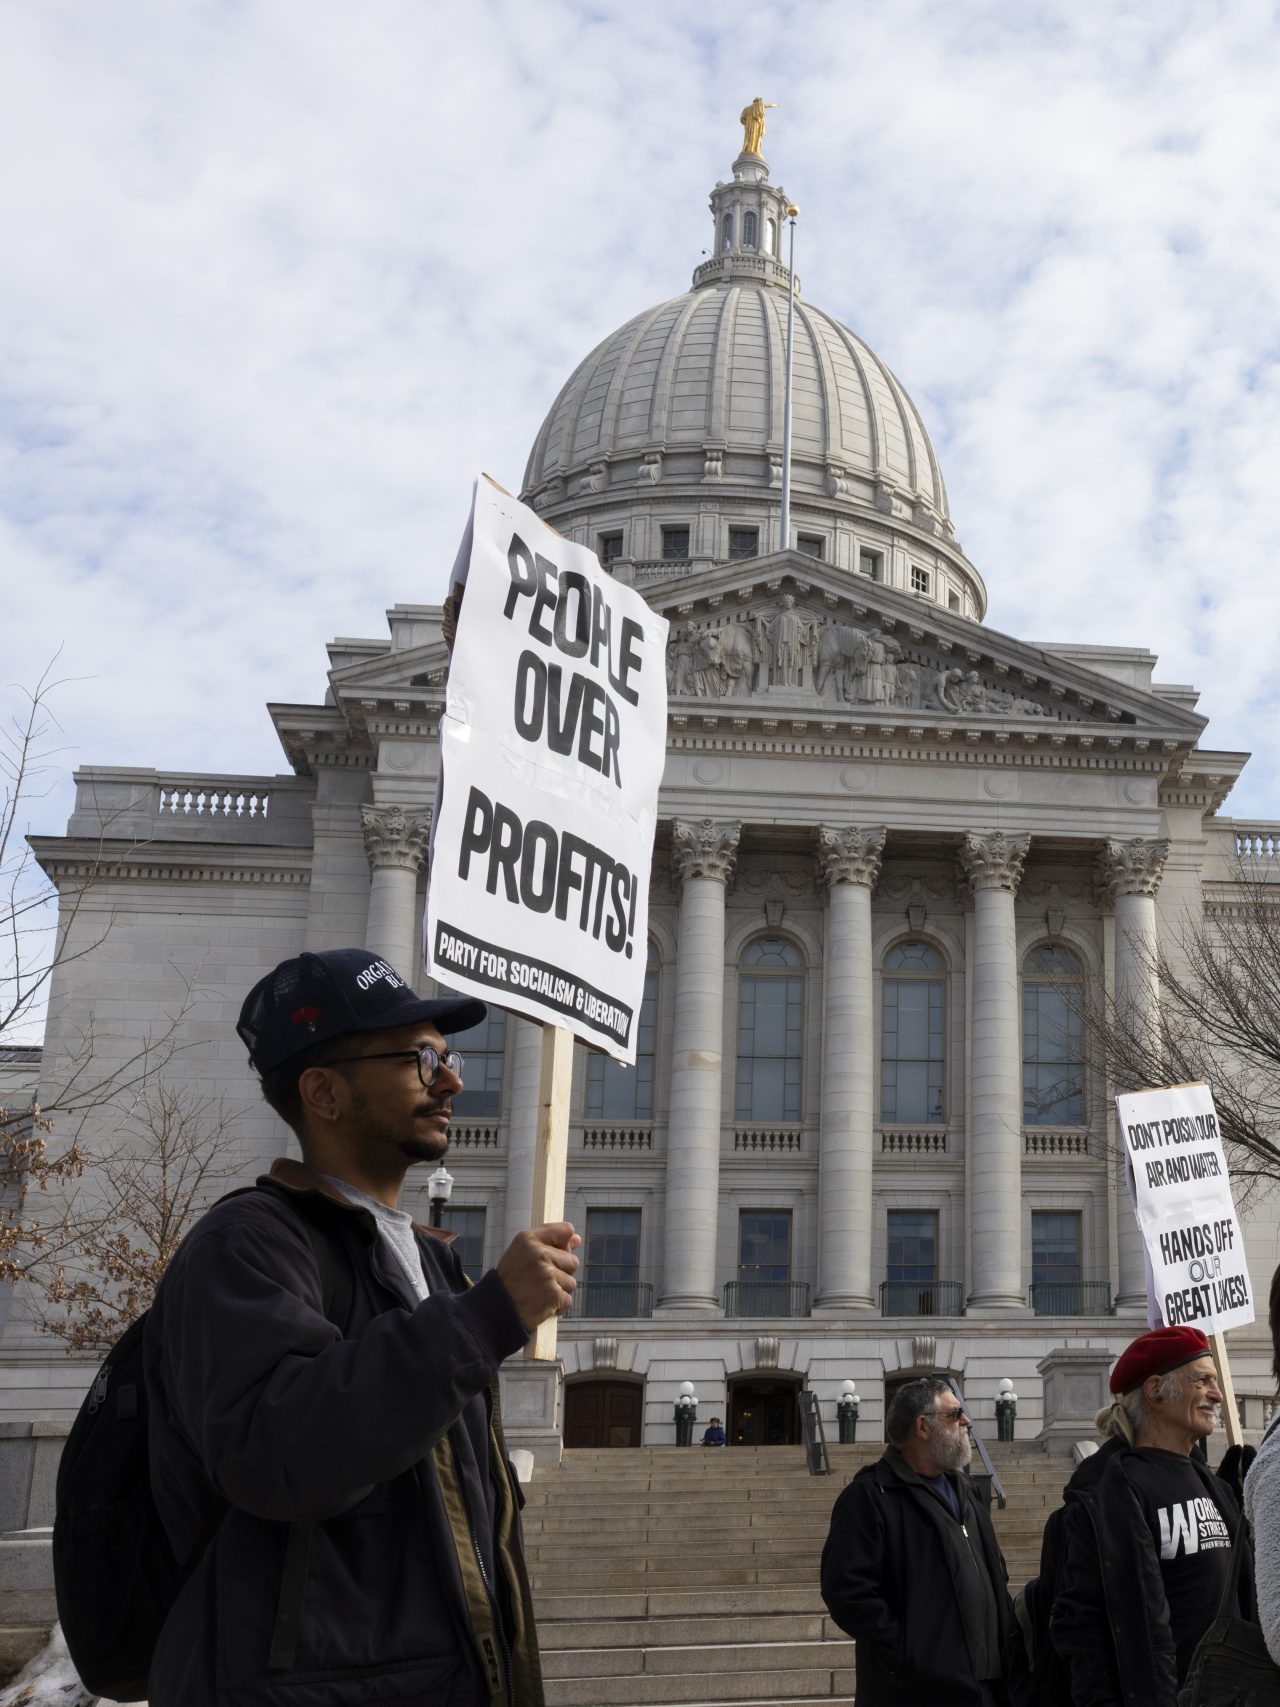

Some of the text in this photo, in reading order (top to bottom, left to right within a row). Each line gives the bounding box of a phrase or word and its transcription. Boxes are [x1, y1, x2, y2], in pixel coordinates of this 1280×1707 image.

[504, 532, 644, 707] PEOPLE
[514, 649, 621, 789] OVER
[458, 785, 638, 959] PROFITS!
[439, 932, 630, 1037] PARTY FOR SOCIALISM & LIBERATION
[1128, 1113, 1218, 1151] DON'T POISON OUR
[1146, 1151, 1222, 1188] AIR AND WATER
[1160, 1219, 1234, 1265] HANDS OFF
[1188, 1255, 1222, 1283] OUR
[1165, 1274, 1249, 1327] GREAT LAKES!
